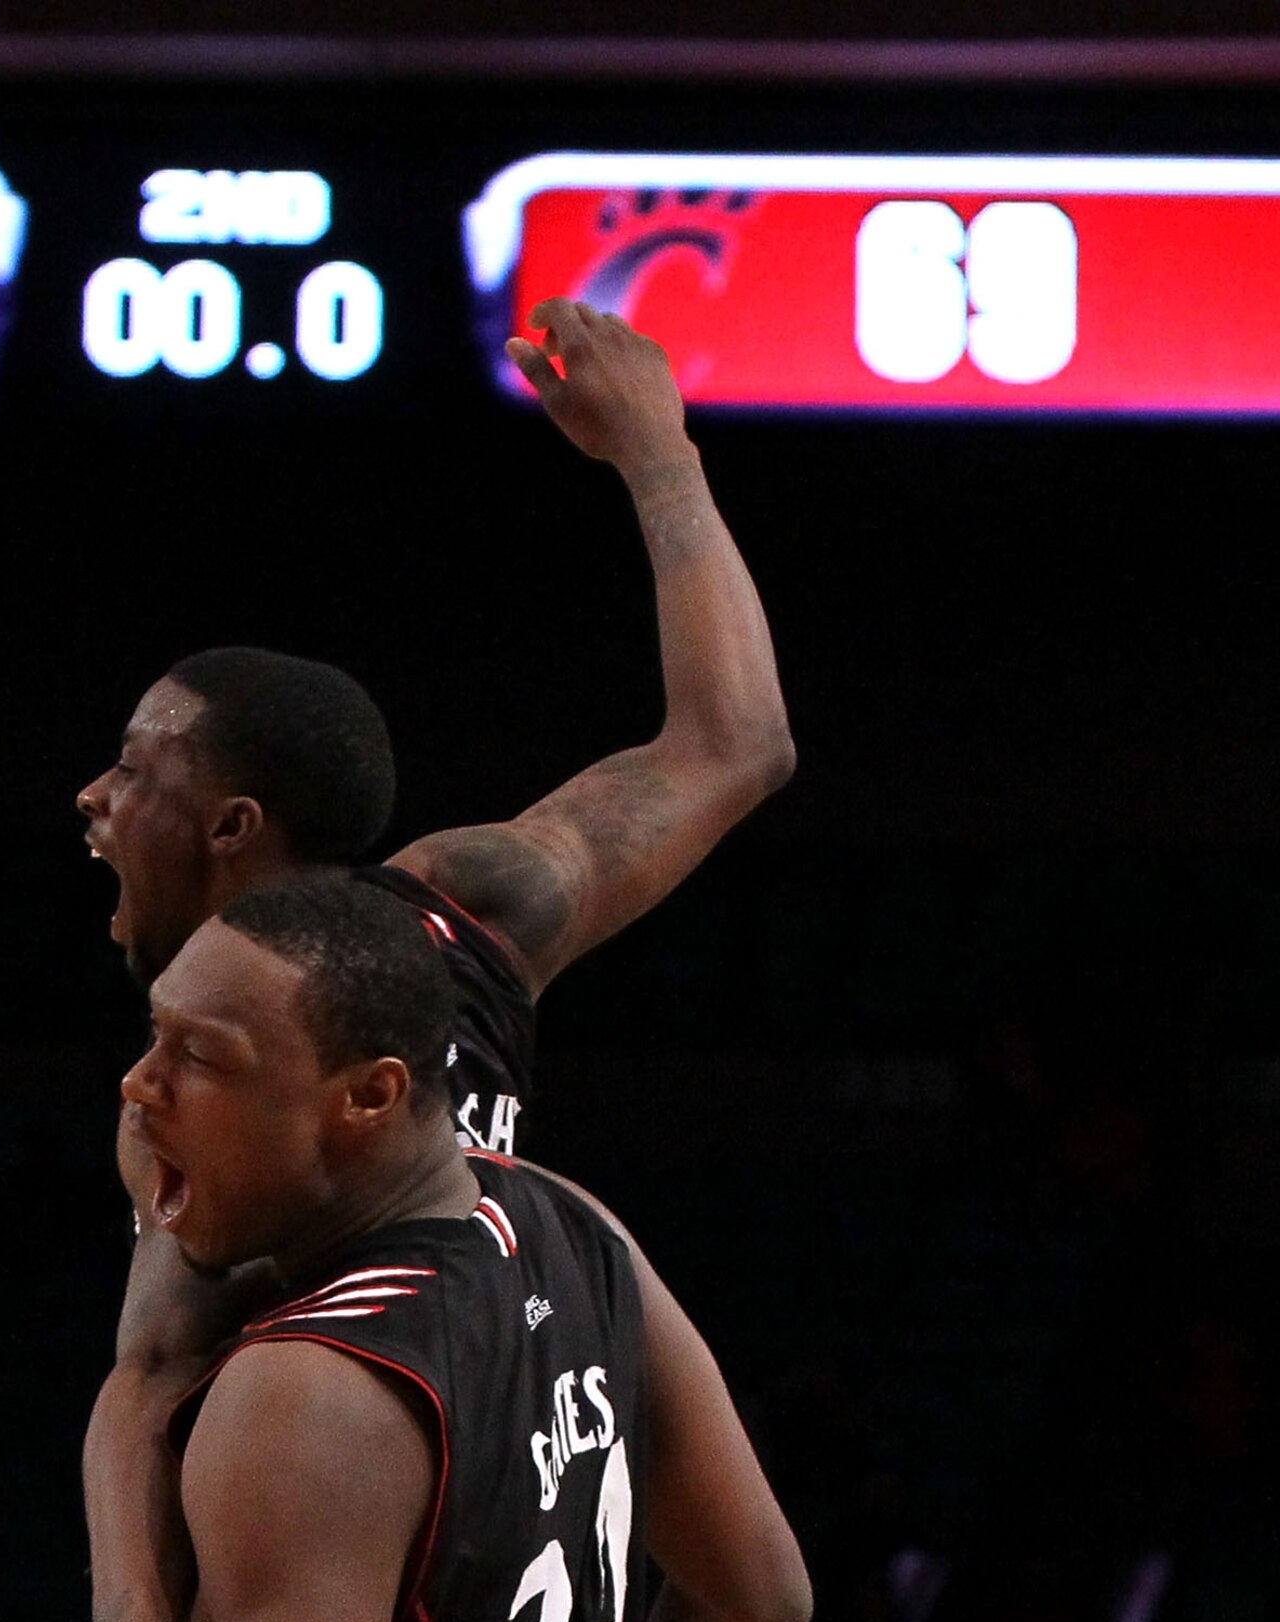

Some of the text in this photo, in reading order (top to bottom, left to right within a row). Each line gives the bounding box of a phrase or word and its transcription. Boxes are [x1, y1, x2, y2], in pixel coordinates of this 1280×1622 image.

[139, 169, 331, 245] 2ND
[81, 256, 383, 382] 00.0
[855, 200, 1078, 384] 69
